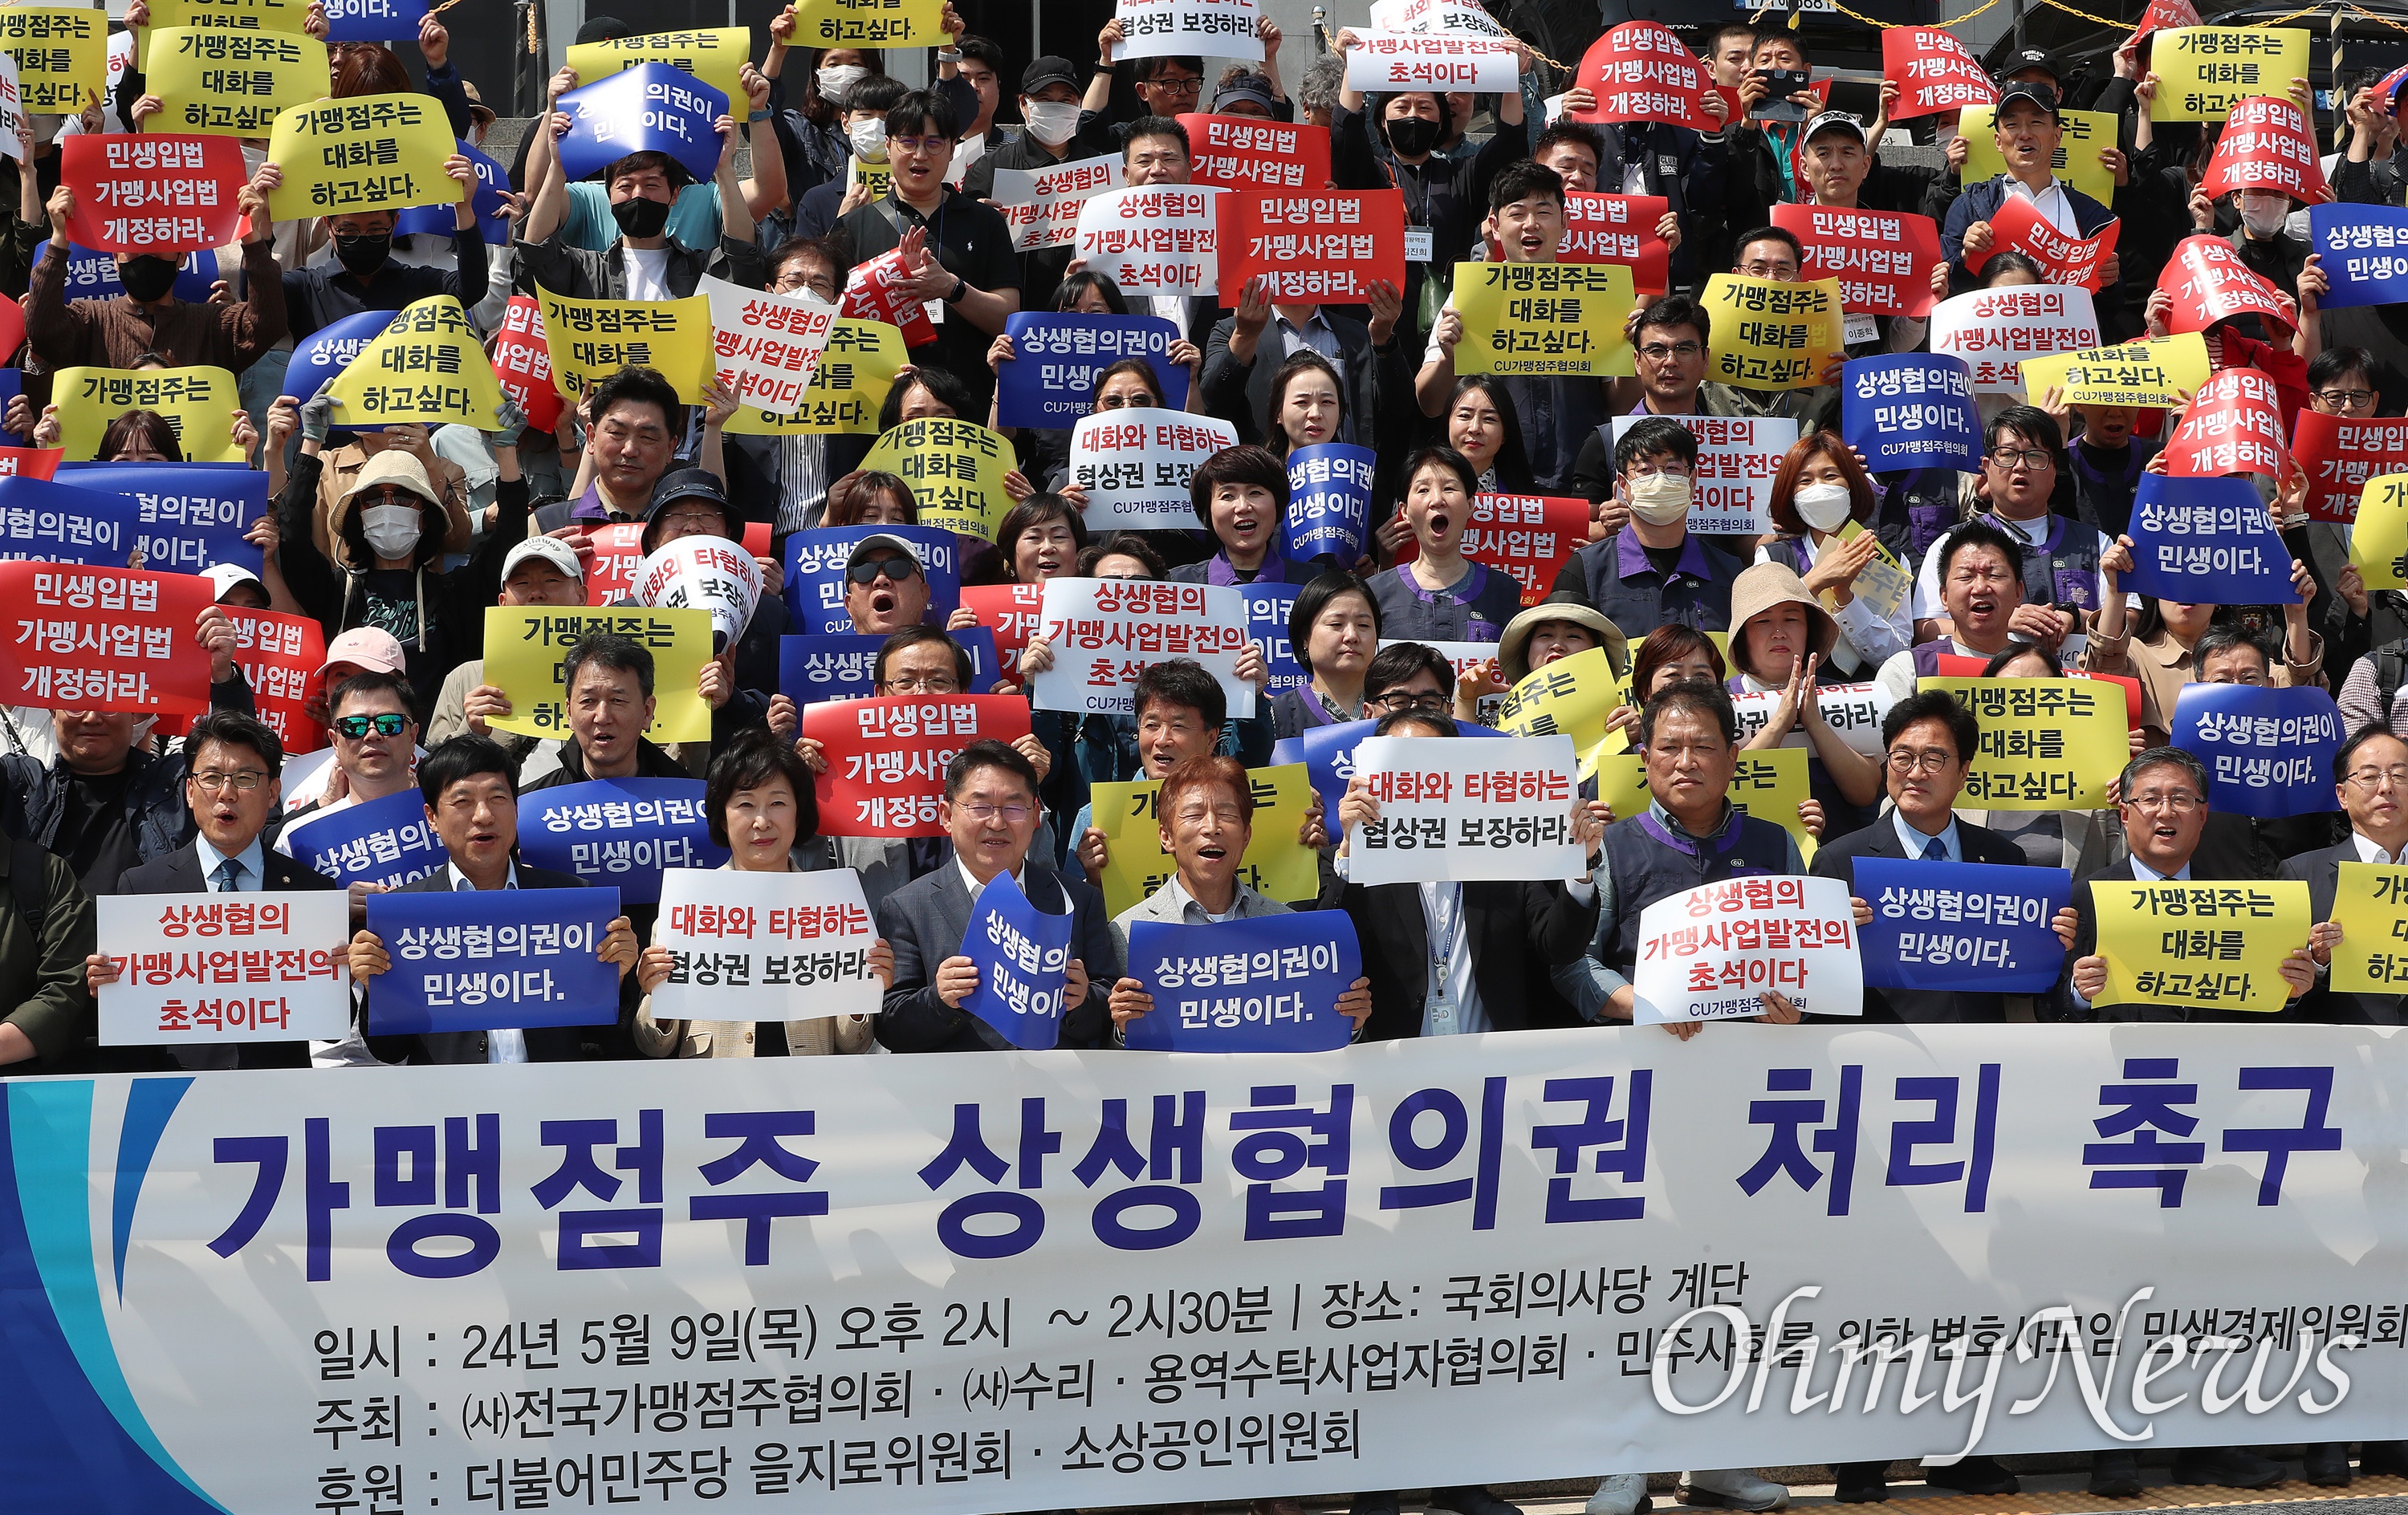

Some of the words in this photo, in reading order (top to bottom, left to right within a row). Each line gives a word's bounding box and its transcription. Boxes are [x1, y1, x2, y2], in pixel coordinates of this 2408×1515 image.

[820, 18, 916, 42] 하고싶다.
[1121, 14, 1173, 36] 협상권
[179, 35, 302, 63] 가맹점주는
[2178, 33, 2283, 55] 가맹점주는
[202, 70, 274, 95] 대화를
[1389, 63, 1478, 84] 초석이다
[1601, 61, 1697, 90] 가맹사업법
[2199, 63, 2260, 83] 대화를
[295, 100, 422, 135] 가맹점주는
[1609, 93, 1691, 120] 개정하라.
[2228, 104, 2303, 134] 민생입법
[323, 138, 400, 169] 대화를
[1208, 124, 1297, 153] 민생입법
[2219, 133, 2311, 165] 가맹사업법
[106, 141, 204, 169] 민생입법
[1034, 164, 1111, 196] 상생협의
[1194, 155, 1305, 186] 가맹사업법
[2222, 160, 2305, 193] 개정하라.
[96, 180, 218, 207] 가맹사업법
[311, 174, 421, 207] 하고싶다.
[1118, 193, 1205, 219] 상생협의
[1260, 199, 1360, 224] 민생입법
[104, 217, 214, 244] 개정하라.
[1812, 213, 1901, 242] 민생입법
[1249, 235, 1373, 260] 가맹사업법
[1803, 244, 1912, 277] 가맹사업법
[1119, 263, 1202, 288] 초석이다
[1258, 271, 1365, 297] 개정하라.
[1486, 266, 1608, 291] 가맹점주는
[1510, 299, 1582, 323] 대화를
[1723, 284, 1828, 315] 가맹점주는
[1972, 292, 2064, 317] 상생협의
[548, 303, 677, 333] 가맹점주는
[742, 299, 832, 339] 상생협의
[1022, 327, 1170, 355] 상생협의권이
[1492, 329, 1596, 355] 하고싶다.
[1739, 323, 1808, 348] 대화를
[1940, 327, 2096, 350] 가맹사업발전의
[381, 345, 461, 374] 대화를
[574, 342, 651, 367] 대화를
[1495, 360, 1591, 372] CU가맹점주협의회
[1722, 352, 1813, 382] 하고싶다.
[82, 376, 211, 403] 가맹점주는
[2065, 366, 2172, 387] 하고싶다.
[363, 388, 475, 414] 하고싶다.
[2196, 376, 2278, 411] 민생입법
[1875, 408, 1970, 433] 민생이다.
[880, 421, 999, 457] 가맹점주는
[1083, 424, 1147, 452] 대화와
[1881, 440, 1968, 457] CU가맹점주협의회
[902, 453, 978, 483] 대화를
[1077, 464, 1144, 489] 협상권
[2140, 503, 2280, 536] 상생협의권이
[2158, 546, 2270, 575] 민생이다.
[33, 574, 158, 612] 민생입법
[1093, 583, 1206, 616] 상생협의
[15, 619, 173, 660] 가맹사업법
[1049, 619, 1246, 652] 가맹사업발전의
[20, 666, 158, 705] 개정하라.
[858, 704, 977, 738] 민생입법
[2196, 711, 2336, 747] 상생협의권이
[1464, 770, 1569, 803] 타협하는
[1967, 772, 2084, 801] 하고싶다.
[2216, 756, 2316, 787] 민생이다.
[1363, 816, 1446, 849] 협상권
[571, 838, 703, 873] 민생이다.
[1686, 879, 1804, 916] 상생협의
[1879, 886, 2048, 928] 상생협의권이
[2131, 888, 2275, 916] 가맹점주는
[158, 902, 290, 938] 상생협의
[670, 905, 756, 939] 대화와
[770, 904, 868, 941] 타협하는
[396, 922, 593, 959] 상생협의권이
[1645, 920, 1851, 961] 가맹사업발전의
[1899, 933, 2016, 968] 민생이다.
[2162, 931, 2244, 960] 대화를
[763, 950, 873, 985] 보장하라.
[1154, 941, 1338, 989] 상생협의권이
[1687, 959, 1808, 992] 초석이다
[423, 969, 563, 1006] 민생이다.
[2135, 971, 2255, 1001] 하고싶다.
[158, 997, 291, 1031] 초석이다
[1180, 992, 1313, 1029] 민생이다.
[206, 1108, 829, 1281] 가맹점주
[917, 1070, 1653, 1260] 상생협의권
[1735, 1063, 2002, 1216] 처리
[2082, 1058, 2342, 1208] 촉구
[314, 1325, 402, 1379] 일시
[462, 1317, 558, 1371] 24년
[580, 1314, 649, 1364] 5월
[671, 1305, 816, 1363] 9일(목)
[834, 1302, 923, 1353] 오후
[942, 1298, 1011, 1348] 2시
[1108, 1286, 1273, 1340] 2시30분
[1322, 1279, 1421, 1330] 장소:
[1442, 1265, 1650, 1319] 국회의사당
[1670, 1261, 1750, 1309] 계단
[314, 1395, 401, 1451] 주최
[462, 1371, 913, 1439] (사)전국가맹점주협의회
[962, 1359, 1094, 1413] (사)수리
[1145, 1333, 1567, 1404] 용역수탁사업자협의회
[1617, 1318, 1813, 1378] 민주사회를
[1837, 1316, 1913, 1367] 위한
[1930, 1307, 2123, 1361] 변호사모임
[2145, 1303, 2408, 1356] 민생경제위원회
[315, 1464, 404, 1515] 후원
[466, 1444, 732, 1509] 더불어민주당
[750, 1428, 1012, 1497] 을지로위원회
[1061, 1409, 1360, 1473] 소상공인위원회
